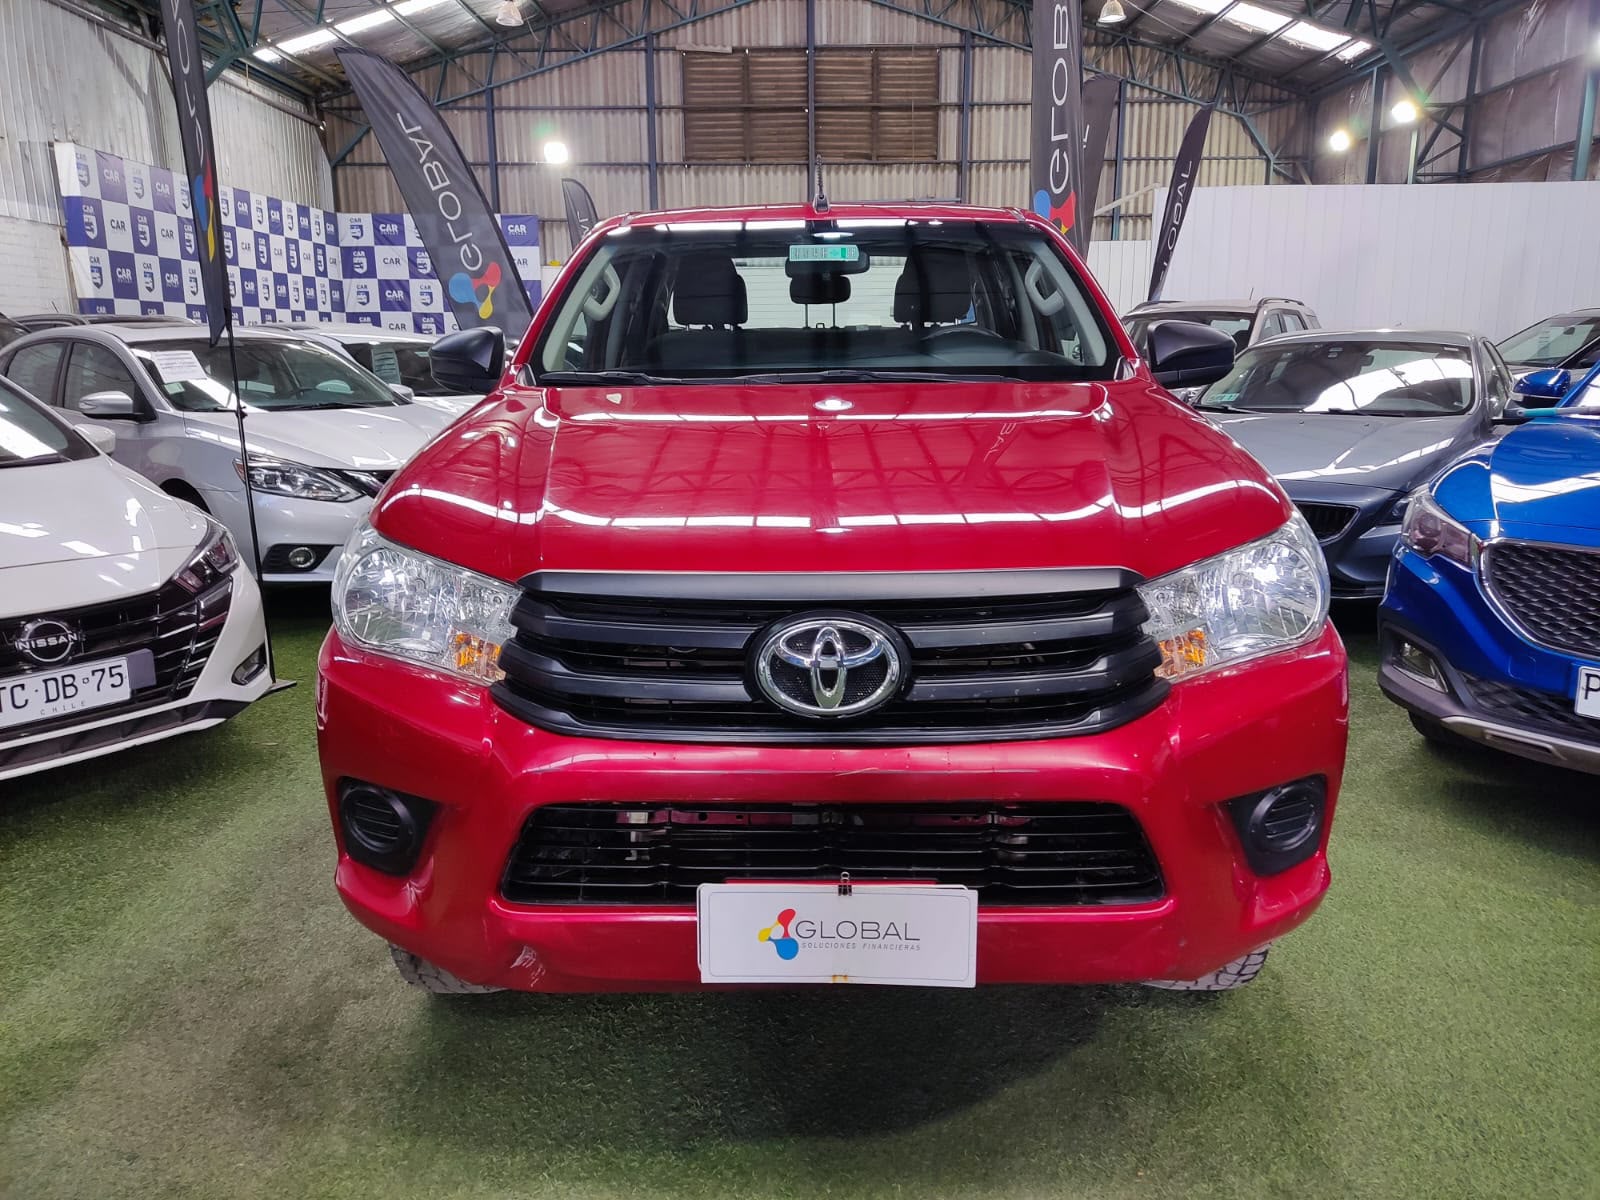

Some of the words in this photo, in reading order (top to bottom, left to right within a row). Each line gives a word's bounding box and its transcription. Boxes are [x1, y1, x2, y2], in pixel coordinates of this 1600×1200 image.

[103, 168, 120, 184] CAR
[155, 182, 170, 195] CAR
[110, 219, 127, 232] CAR
[379, 223, 399, 233] CAR
[507, 224, 527, 233] CAR
[160, 228, 175, 240] CAR
[382, 257, 401, 266] CAR
[115, 267, 132, 280] CAR
[165, 272, 179, 283] CAR
[385, 290, 404, 299] CAR
[388, 323, 407, 331] CAR
[15, 632, 78, 651] NISSAN
[40, 701, 86, 716] CHILE
[795, 920, 921, 941] GLOBAL
[801, 942, 857, 950] SOLUCIONES
[862, 943, 921, 951] FINANCIERAS
